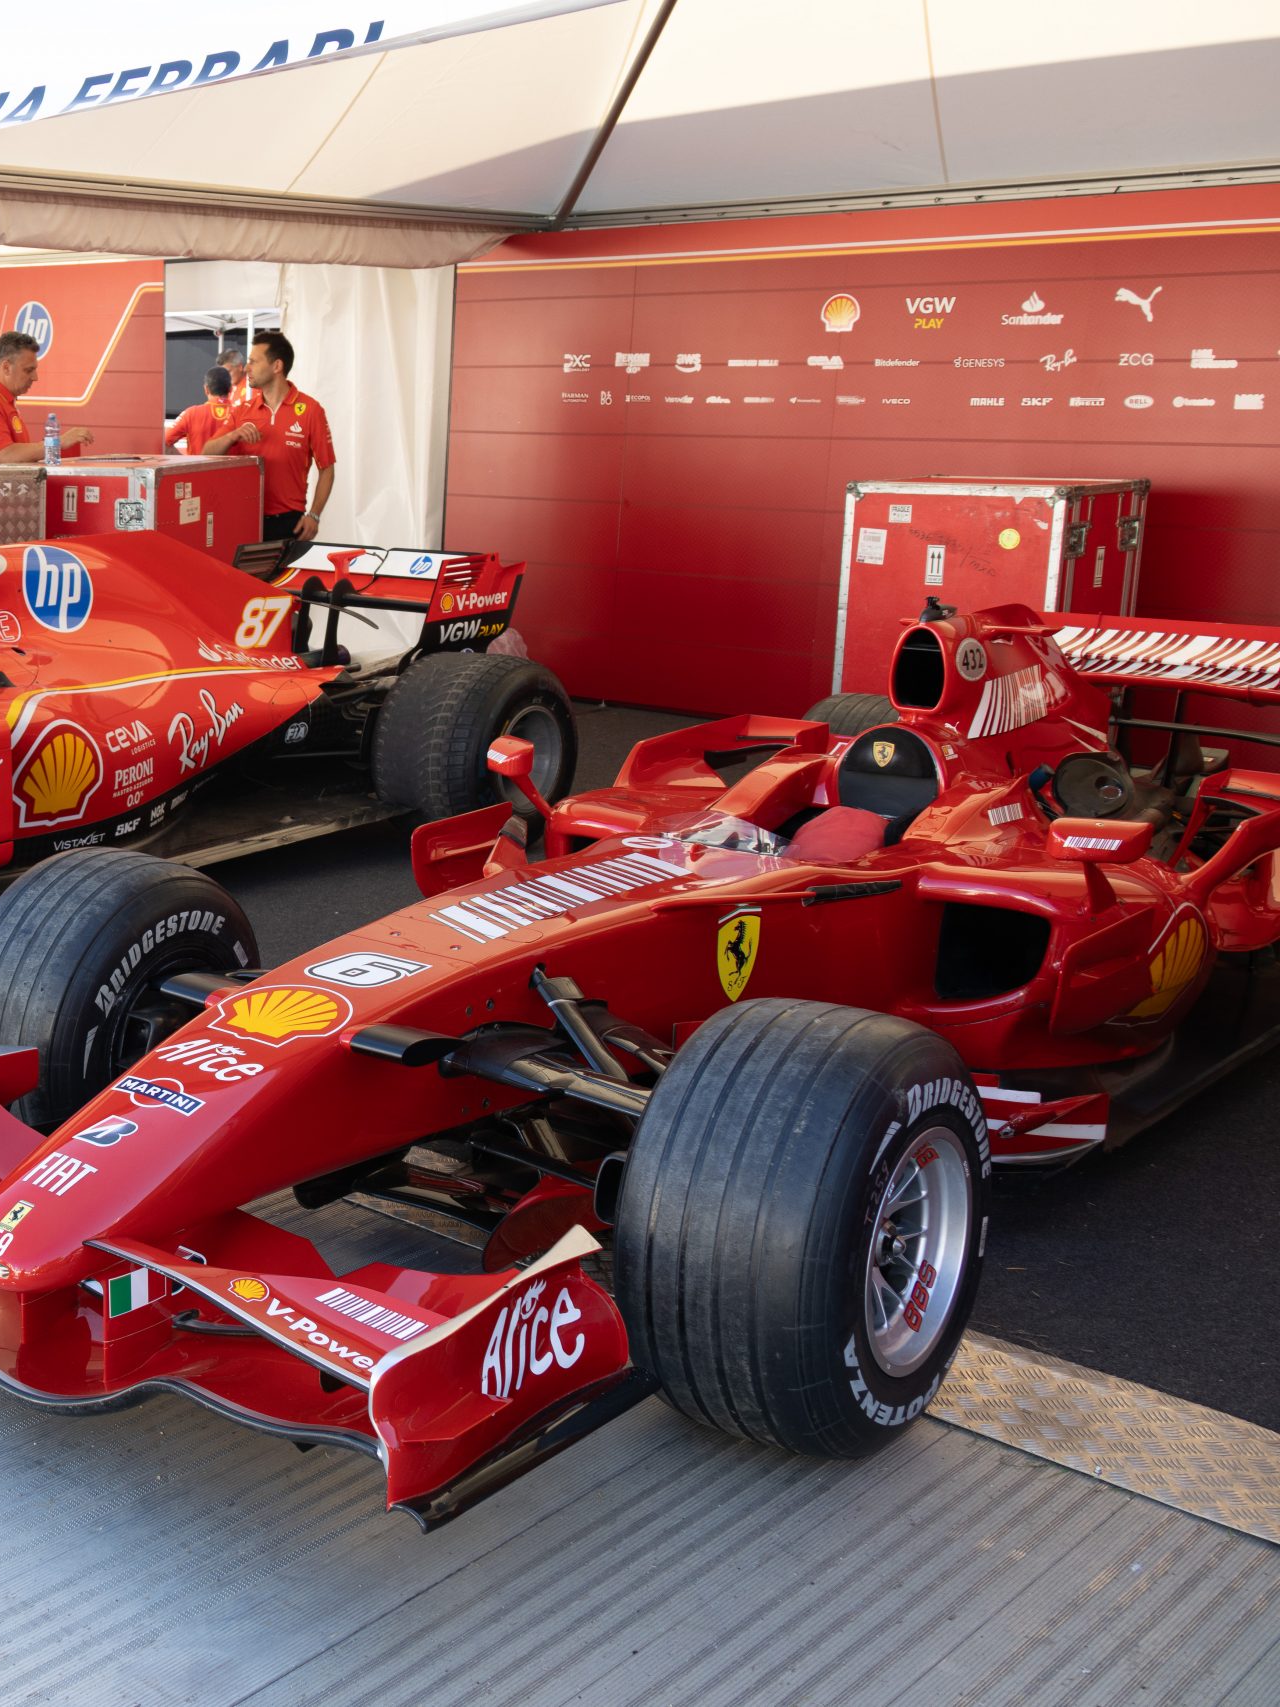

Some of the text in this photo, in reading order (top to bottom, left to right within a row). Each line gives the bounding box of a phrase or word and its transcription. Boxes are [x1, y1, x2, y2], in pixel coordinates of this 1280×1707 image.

[906, 296, 956, 314] VGW
[914, 318, 944, 329] PLAY
[1001, 312, 1064, 326] Santander
[875, 358, 920, 368] Bitdefender
[962, 357, 1005, 368] GENESYS
[1119, 353, 1154, 366] ZCG
[970, 397, 1005, 406] MAHLE
[1021, 397, 1053, 406] SKF
[1069, 397, 1105, 406] PIRELLI
[412, 555, 432, 575] hp
[456, 592, 508, 611] V-Power
[235, 595, 293, 649] 87
[440, 618, 505, 645] VGW PLAY
[213, 644, 302, 670] Santander
[962, 648, 984, 671] 432
[130, 738, 157, 756] LOGISTICS
[114, 757, 155, 790] PERONI
[112, 784, 133, 799] NASTRO
[150, 801, 166, 822] NGK
[114, 818, 141, 837] SKF
[94, 909, 226, 1020] BRIDGESTONE
[304, 952, 433, 988] 6
[156, 1038, 265, 1082] Alice
[121, 1078, 197, 1115] MARTINI
[906, 1077, 992, 1180] BRIDGESTONE
[22, 1151, 98, 1196] FIAT
[903, 1259, 937, 1333] BBS
[481, 1284, 585, 1398] Alice
[843, 1332, 940, 1426] POTENZA
